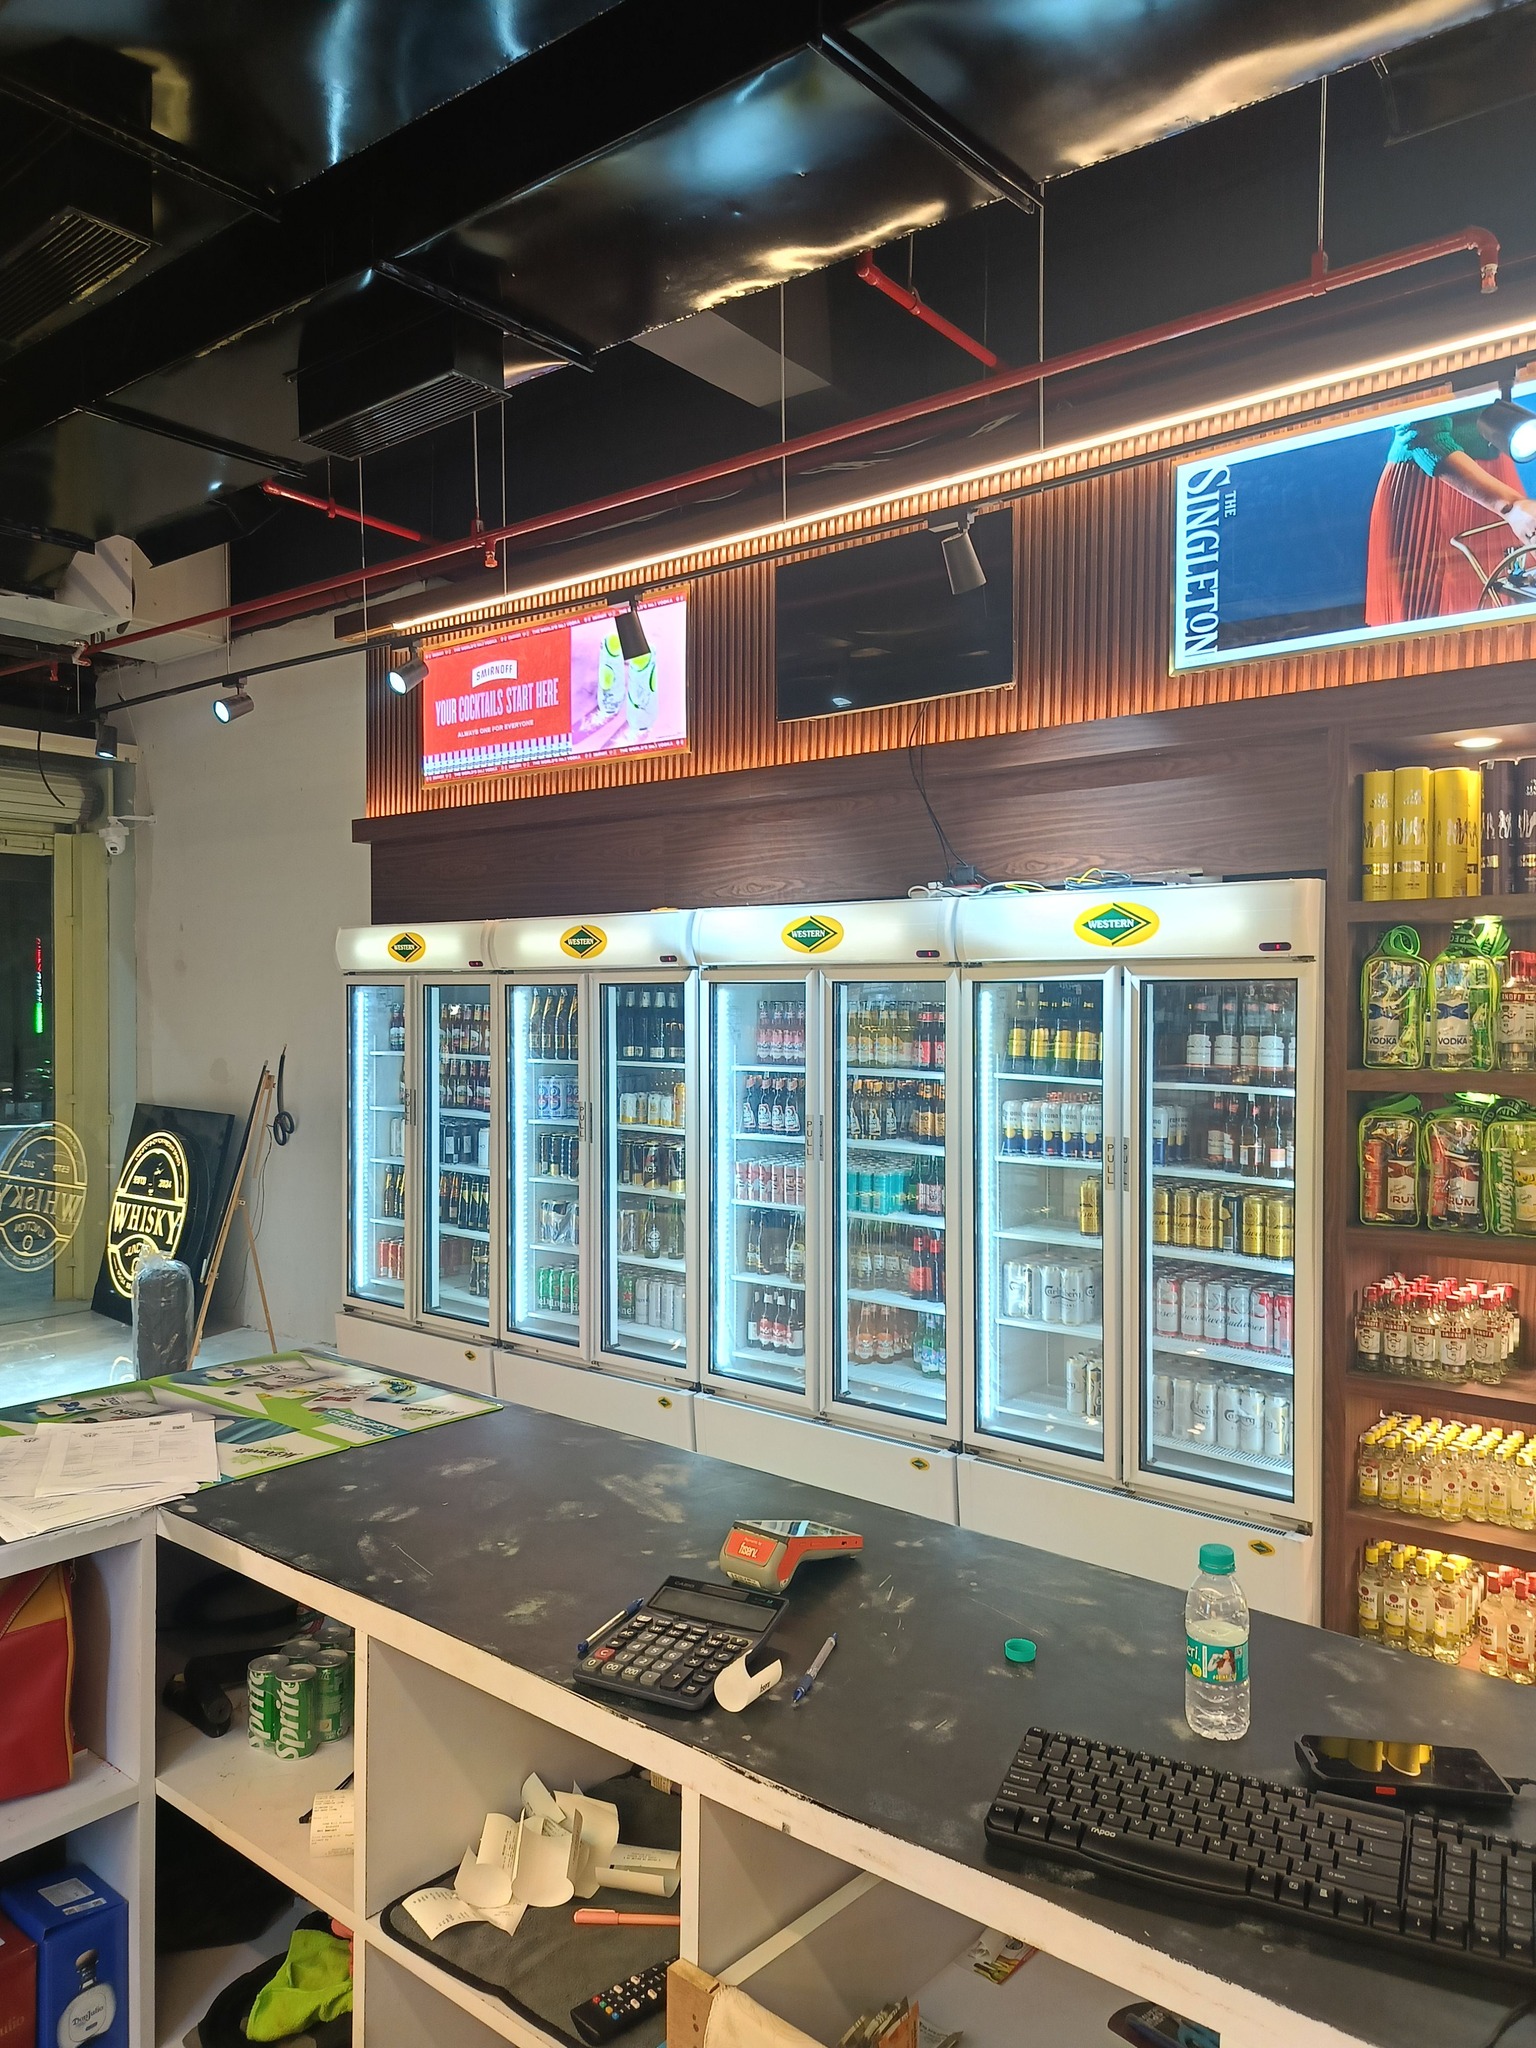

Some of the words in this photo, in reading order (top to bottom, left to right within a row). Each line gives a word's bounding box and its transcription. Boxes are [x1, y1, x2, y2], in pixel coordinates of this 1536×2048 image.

[1224, 490, 1237, 518] THE
[1184, 464, 1232, 657] SINGLETON
[476, 664, 514, 681] SMIRNOFF
[435, 695, 458, 727] YOUR
[458, 687, 504, 722] COCKTAILS
[506, 683, 535, 714] START
[536, 678, 559, 709] HERE
[457, 728, 479, 738] ALWAYS
[492, 724, 504, 732] FOR
[504, 719, 534, 730] EVERYONE
[1087, 916, 1135, 930] WESTERN
[567, 937, 595, 947] WESTERN
[791, 929, 826, 940] WESTERN
[394, 944, 416, 952] WESTERN
[1369, 1037, 1397, 1045] VODKA
[1438, 1037, 1468, 1045] VODKA
[1107, 1144, 1115, 1185] PULL
[1450, 1198, 1476, 1207] RUM
[113, 1202, 182, 1245] WHISKY
[624, 1667, 638, 1676] 000
[275, 1681, 306, 1761] Sprite
[72, 2013, 88, 2026] Don
[86, 2005, 104, 2022] Julio
